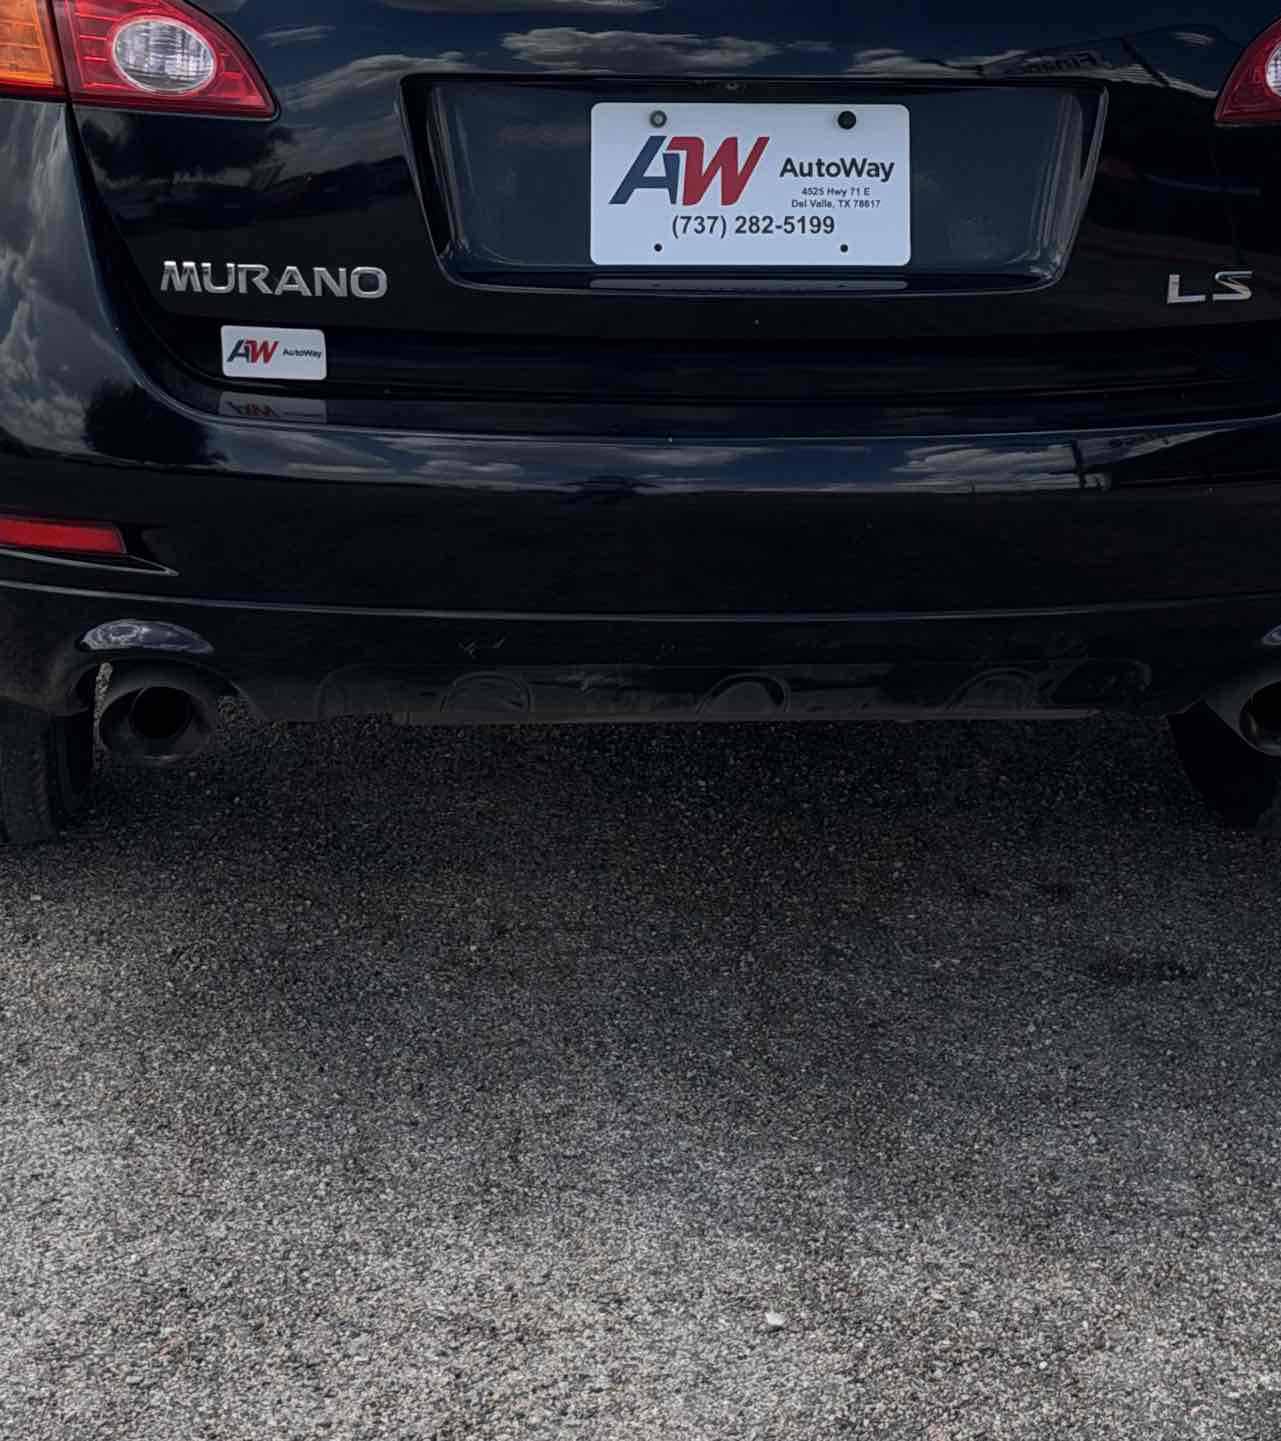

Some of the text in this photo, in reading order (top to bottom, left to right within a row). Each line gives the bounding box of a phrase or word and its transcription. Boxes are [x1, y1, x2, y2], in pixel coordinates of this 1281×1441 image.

[779, 157, 896, 183] AutoWay
[827, 187, 847, 197] Hwy
[863, 187, 871, 196] E
[839, 199, 851, 208] TX
[671, 216, 836, 239] (737) 282-5199
[159, 260, 389, 299] MURANO
[1166, 270, 1254, 304] LS
[282, 347, 322, 358] AutoWay
